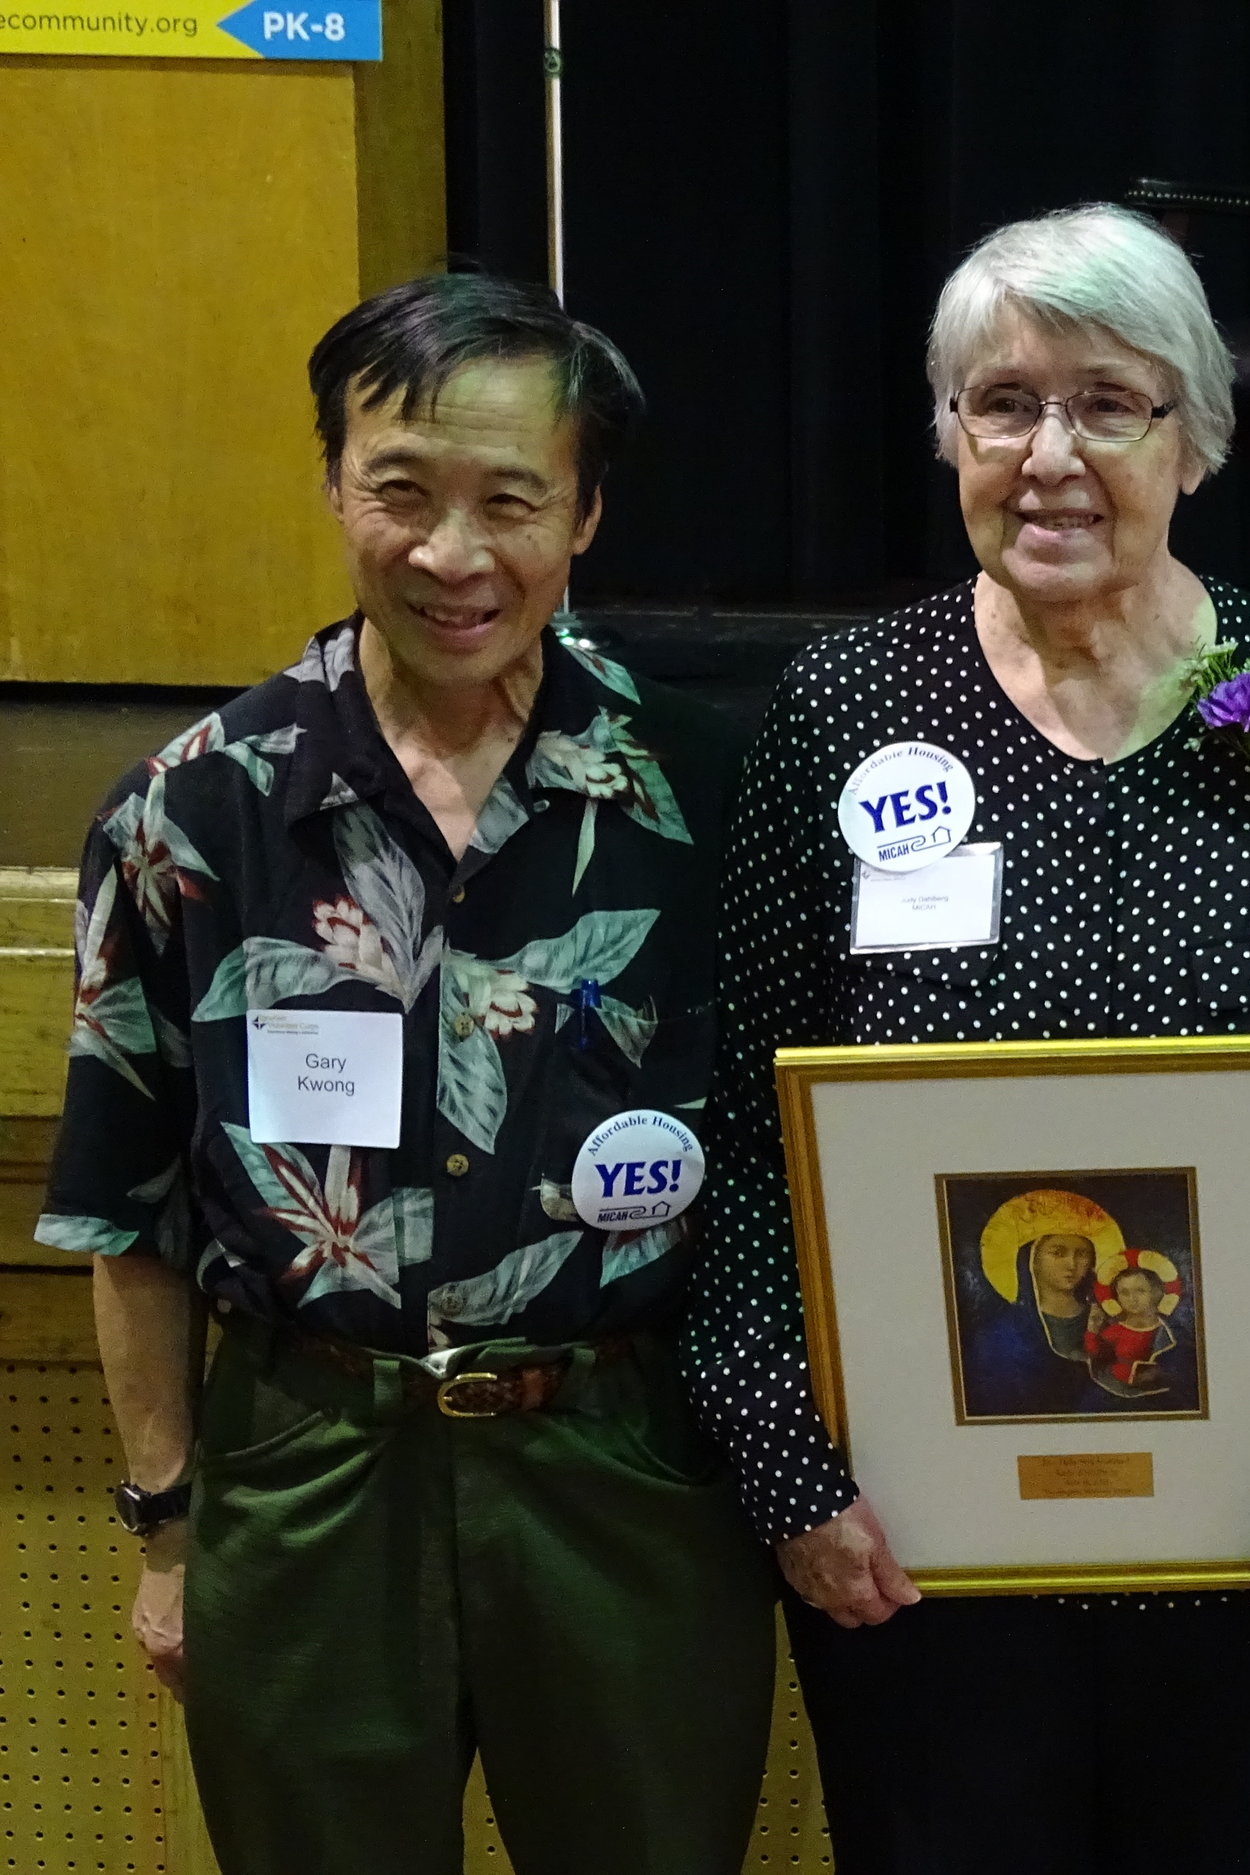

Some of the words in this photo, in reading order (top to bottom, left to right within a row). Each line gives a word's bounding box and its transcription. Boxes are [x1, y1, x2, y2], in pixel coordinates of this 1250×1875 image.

[262, 11, 346, 41] PK-8
[908, 746, 954, 773] Housing
[858, 781, 952, 833] YES!
[879, 843, 910, 862] MICAH
[305, 1053, 346, 1073] Gary
[298, 1076, 355, 1096] Kwong
[588, 1115, 648, 1156] Affordable
[652, 1116, 694, 1152] Housing
[594, 1160, 682, 1198] YES!
[597, 1210, 629, 1223] MICAH
